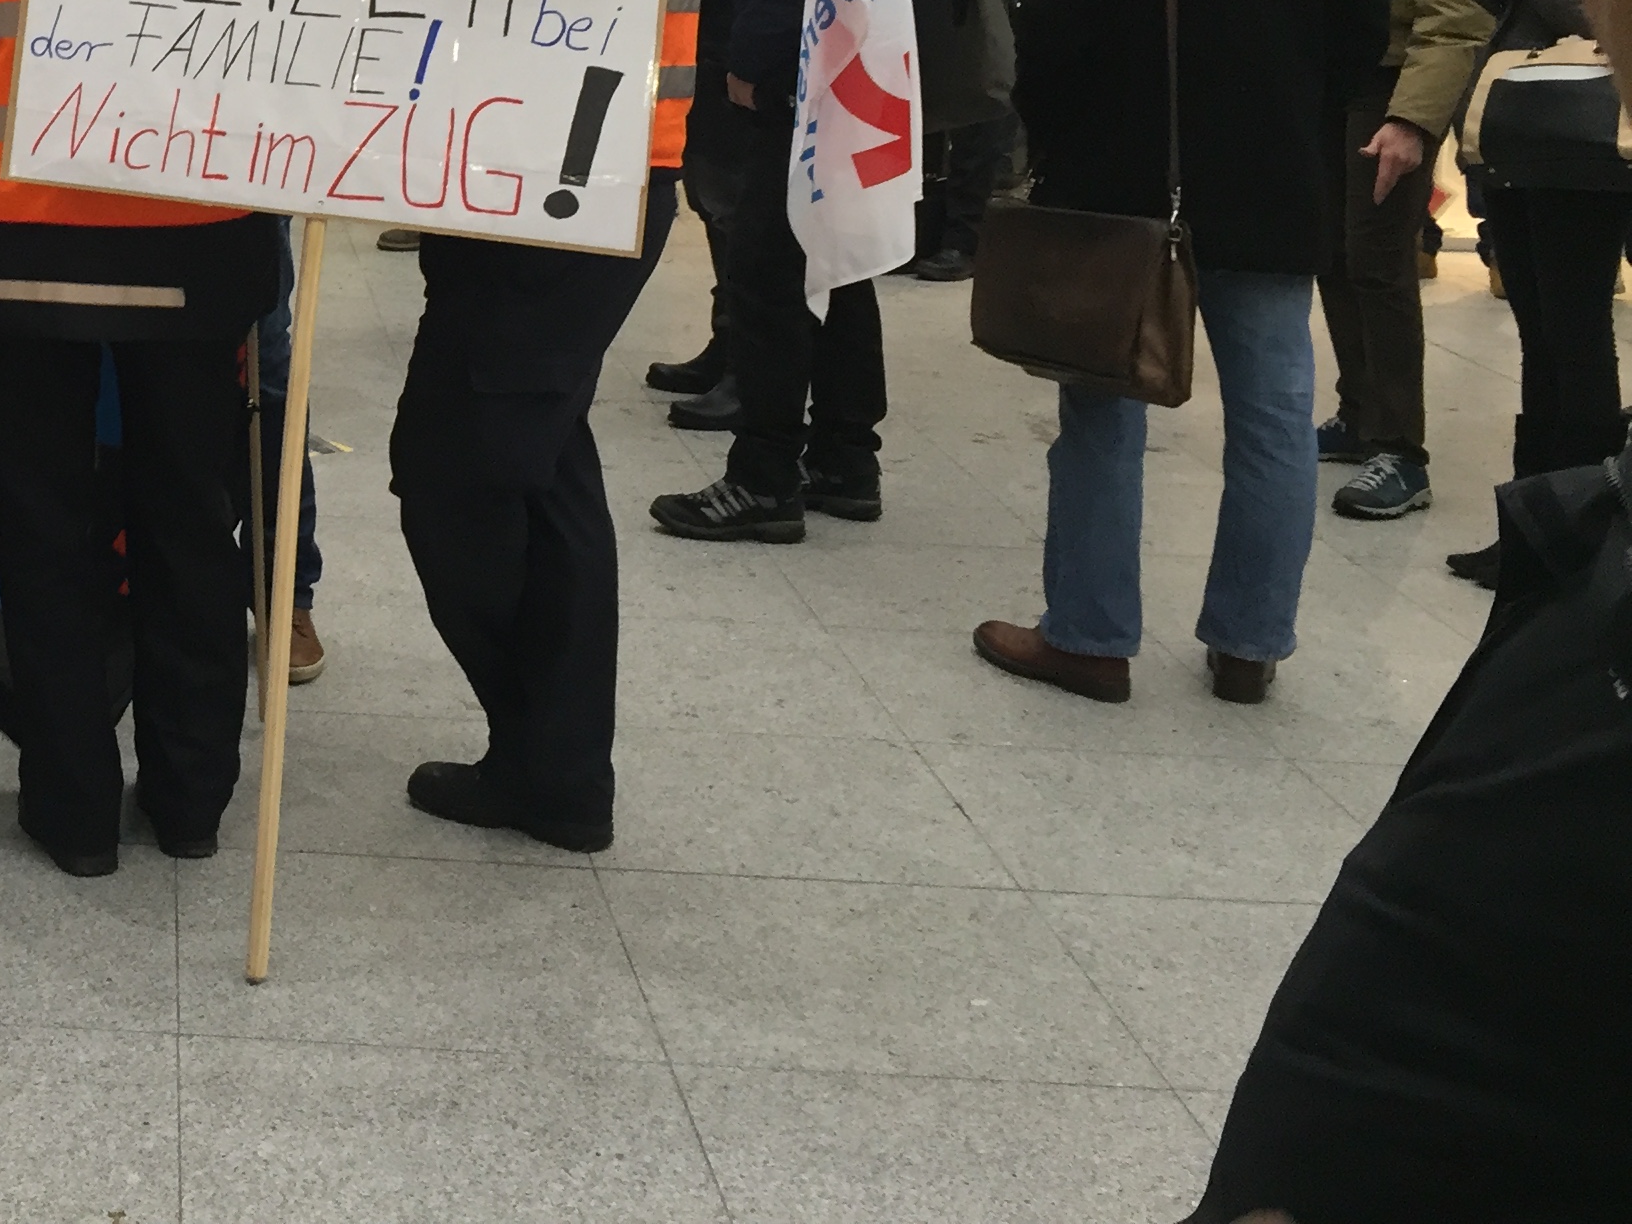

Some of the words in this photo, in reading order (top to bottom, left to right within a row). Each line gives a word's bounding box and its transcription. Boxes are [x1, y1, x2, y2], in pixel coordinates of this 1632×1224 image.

[30, 4, 114, 61] der
[31, 80, 230, 182] Nicht
[248, 121, 317, 195] im
